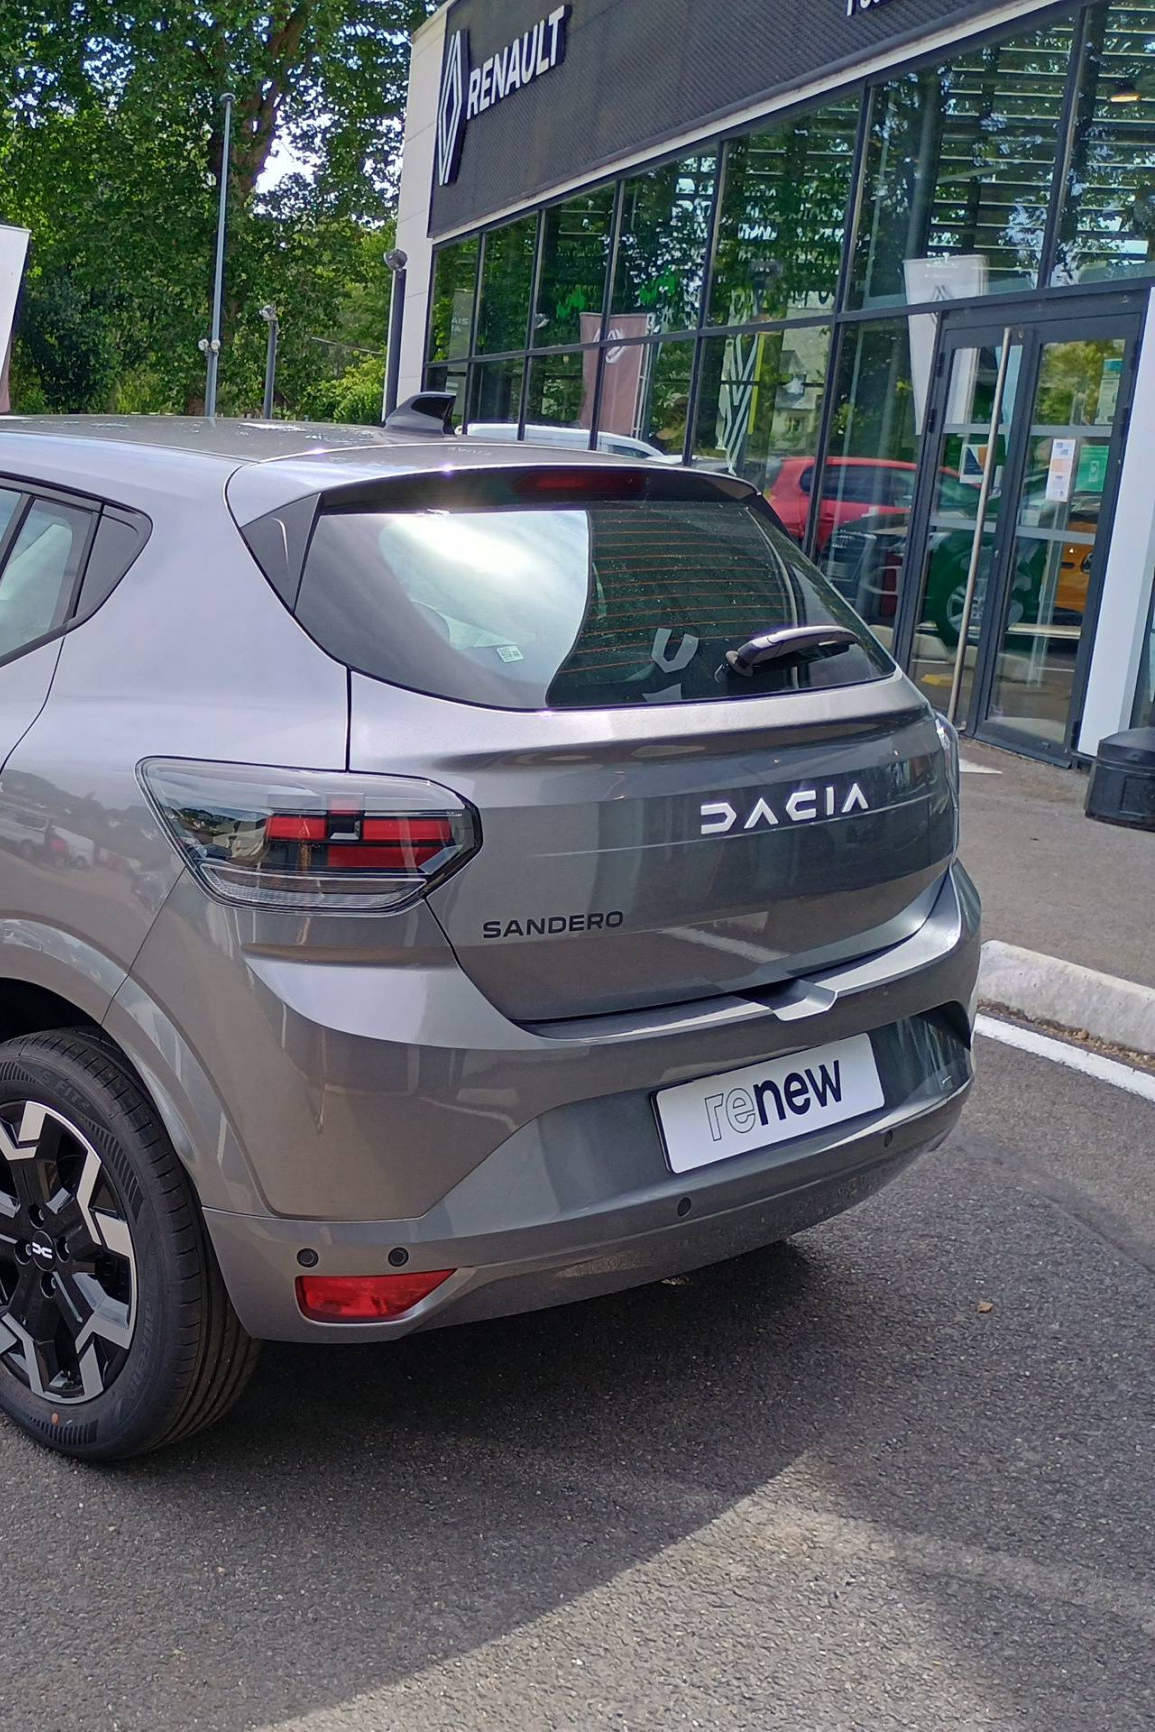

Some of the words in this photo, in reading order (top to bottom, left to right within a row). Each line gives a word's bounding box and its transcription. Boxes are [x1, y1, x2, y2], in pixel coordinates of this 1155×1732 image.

[466, 4, 565, 120] RENAULT
[700, 783, 869, 835] DACIA
[482, 910, 624, 939] SANDERO
[704, 1059, 843, 1142] renew
